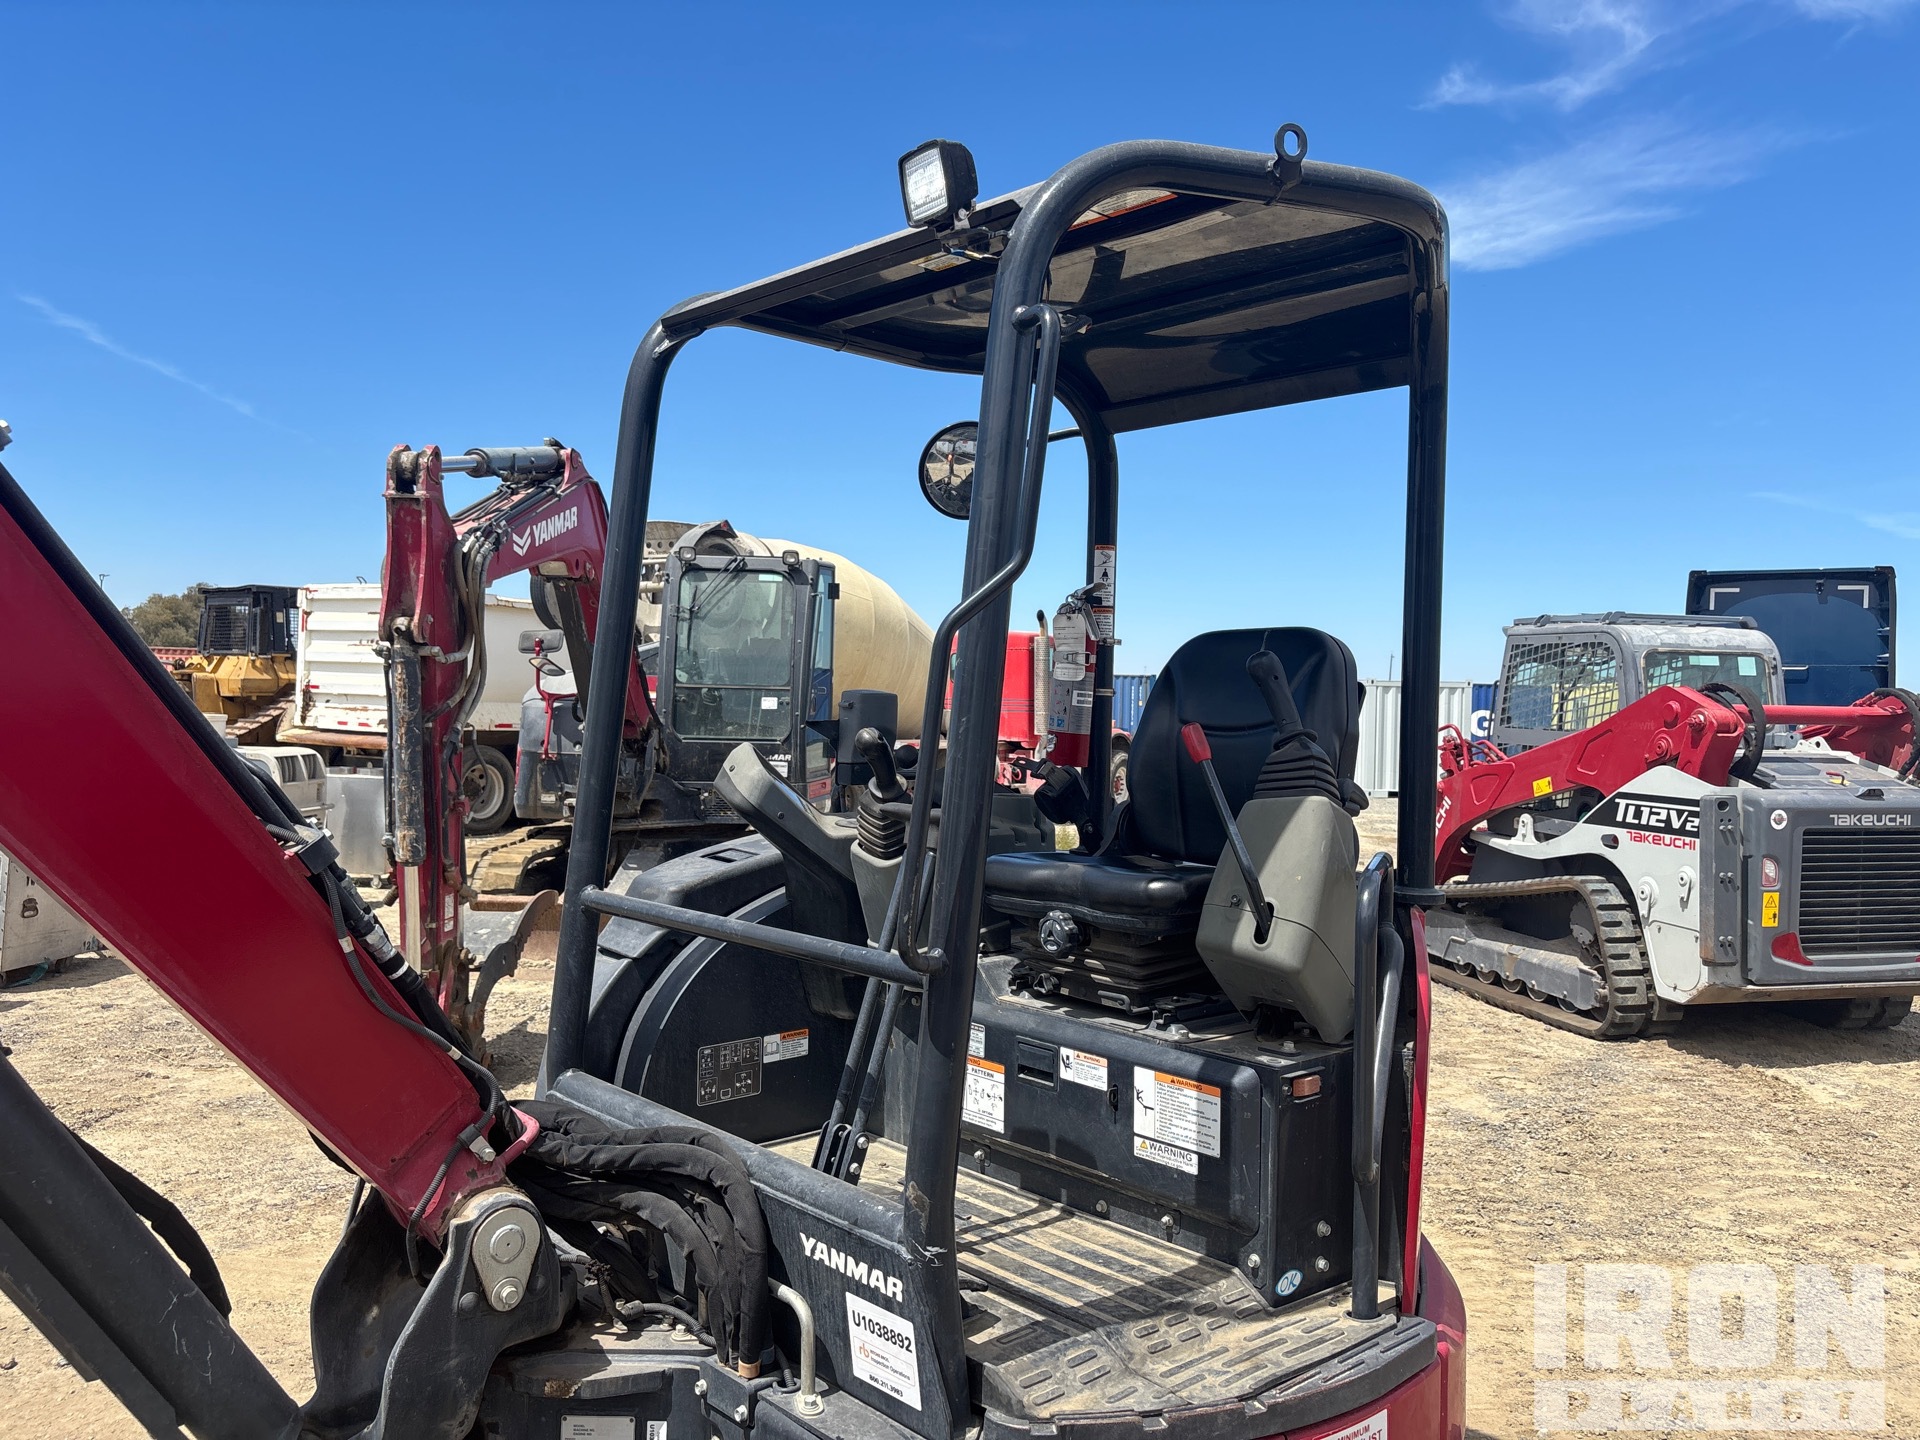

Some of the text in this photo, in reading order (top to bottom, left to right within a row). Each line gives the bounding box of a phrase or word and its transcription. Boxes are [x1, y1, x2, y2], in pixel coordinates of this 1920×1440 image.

[533, 506, 578, 547] YANMAR
[1614, 798, 1700, 832] TL12V2
[971, 1067, 994, 1079] PATTERN
[1176, 1078, 1202, 1090] WARNING
[1149, 1142, 1192, 1162] WARNING
[800, 1232, 904, 1302] YANMAR
[1280, 1272, 1297, 1292] OK
[852, 1310, 913, 1354] U1038892
[871, 1356, 911, 1382] Inspection Operations
